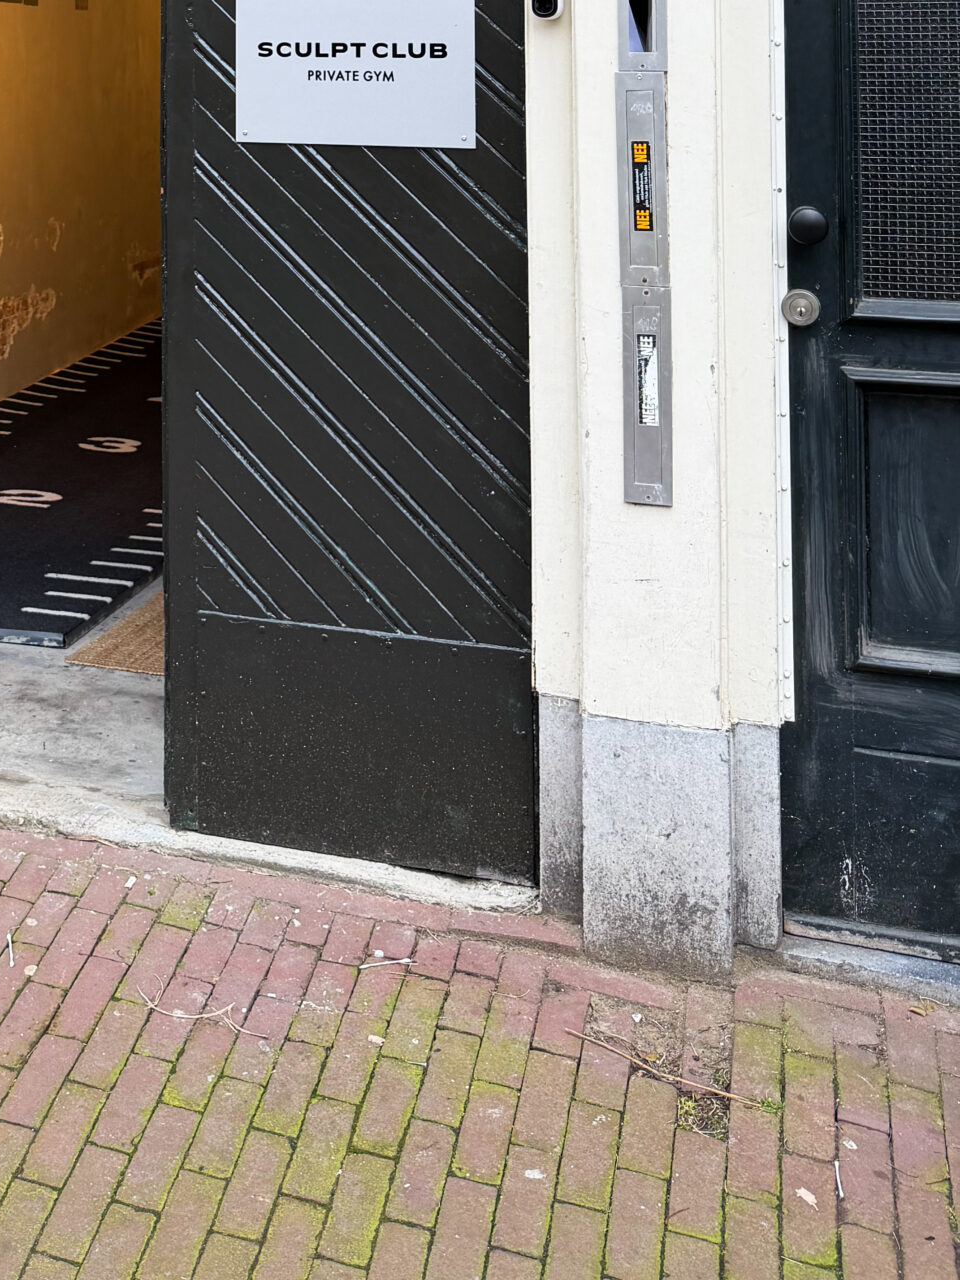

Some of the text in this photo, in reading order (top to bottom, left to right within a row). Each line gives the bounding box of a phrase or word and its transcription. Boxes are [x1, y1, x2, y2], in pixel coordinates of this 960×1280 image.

[257, 41, 449, 59] SCULPT CLUB
[307, 70, 395, 82] PRIVATE GYM
[633, 143, 648, 163] NEE
[636, 210, 651, 230] NEE
[640, 336, 653, 356] NEE
[78, 436, 142, 453] 3
